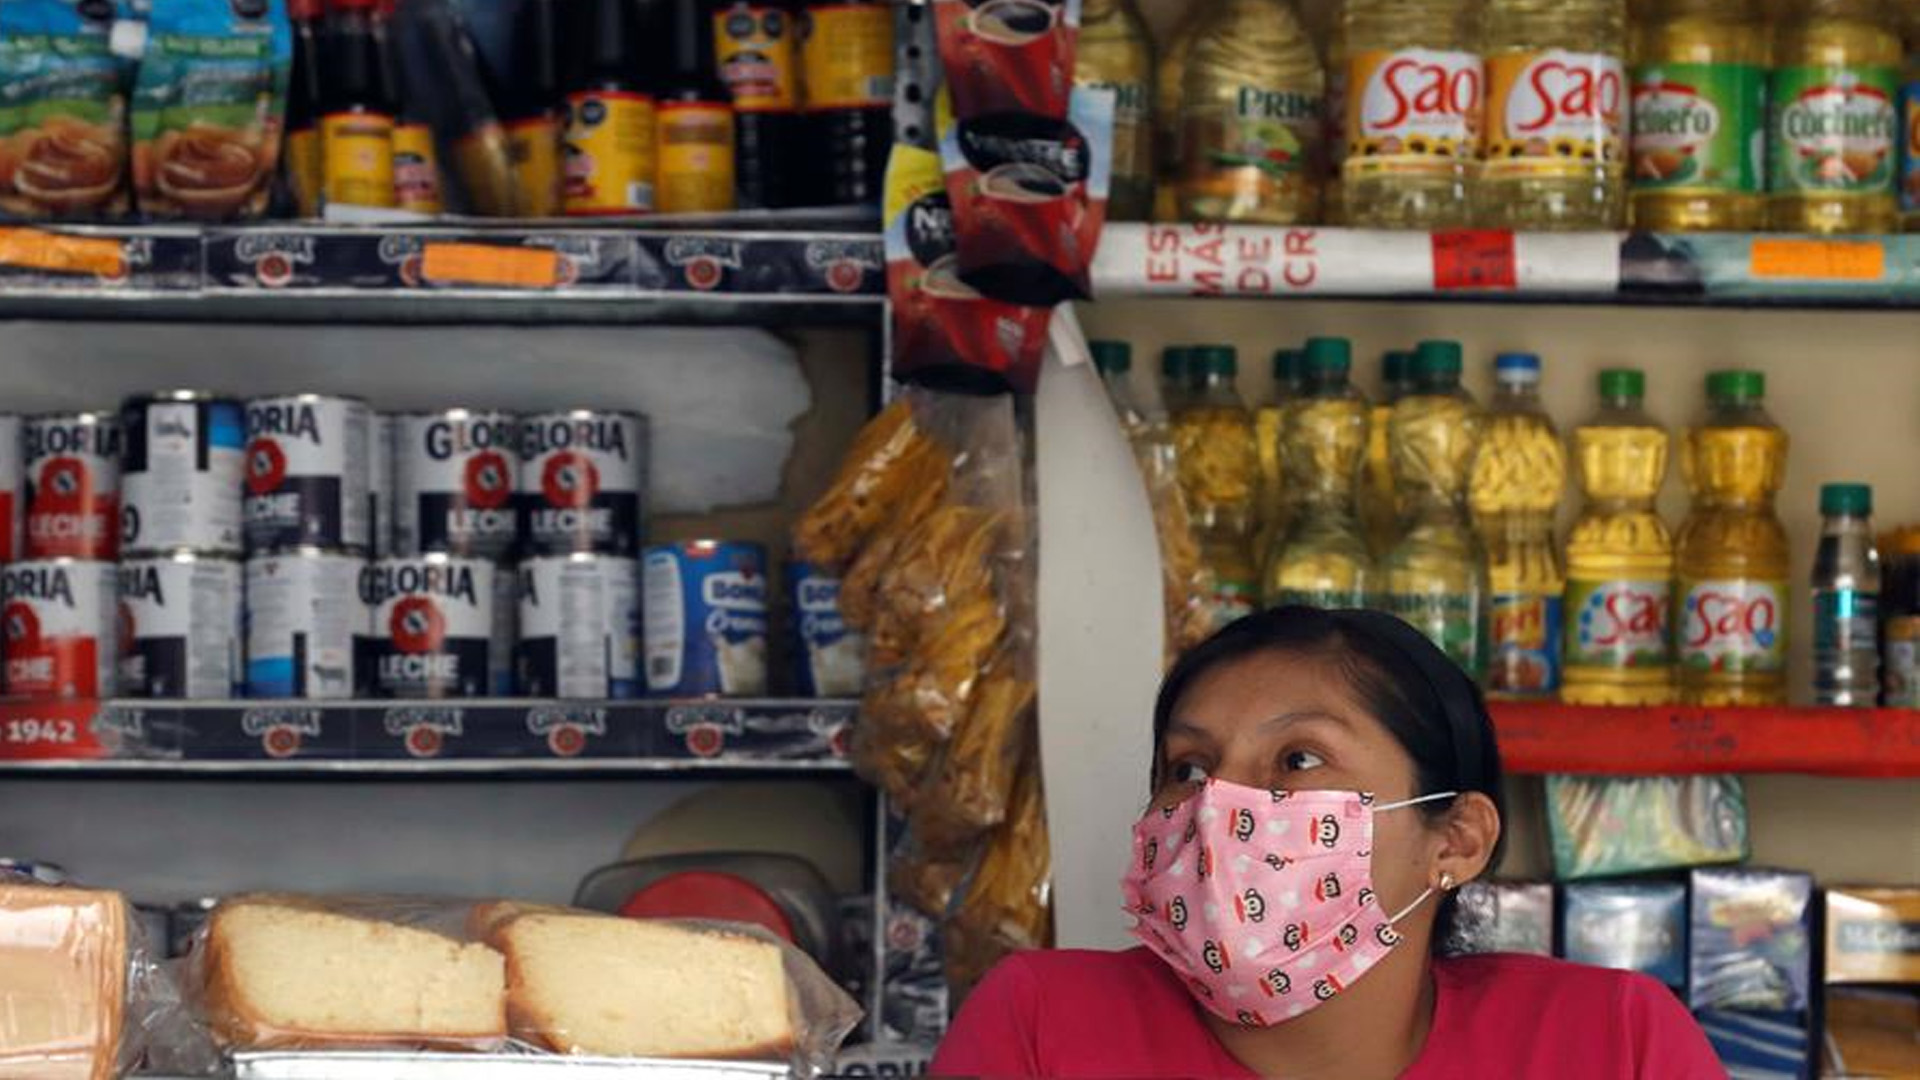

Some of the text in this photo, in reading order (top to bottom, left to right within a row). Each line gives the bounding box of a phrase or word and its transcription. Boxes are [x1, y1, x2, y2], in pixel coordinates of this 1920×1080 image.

[1370, 58, 1478, 129] Sao
[1516, 60, 1620, 131] Sao
[1689, 591, 1774, 648] Sao
[379, 653, 460, 680] LECHE
[6, 718, 76, 744] 1942
